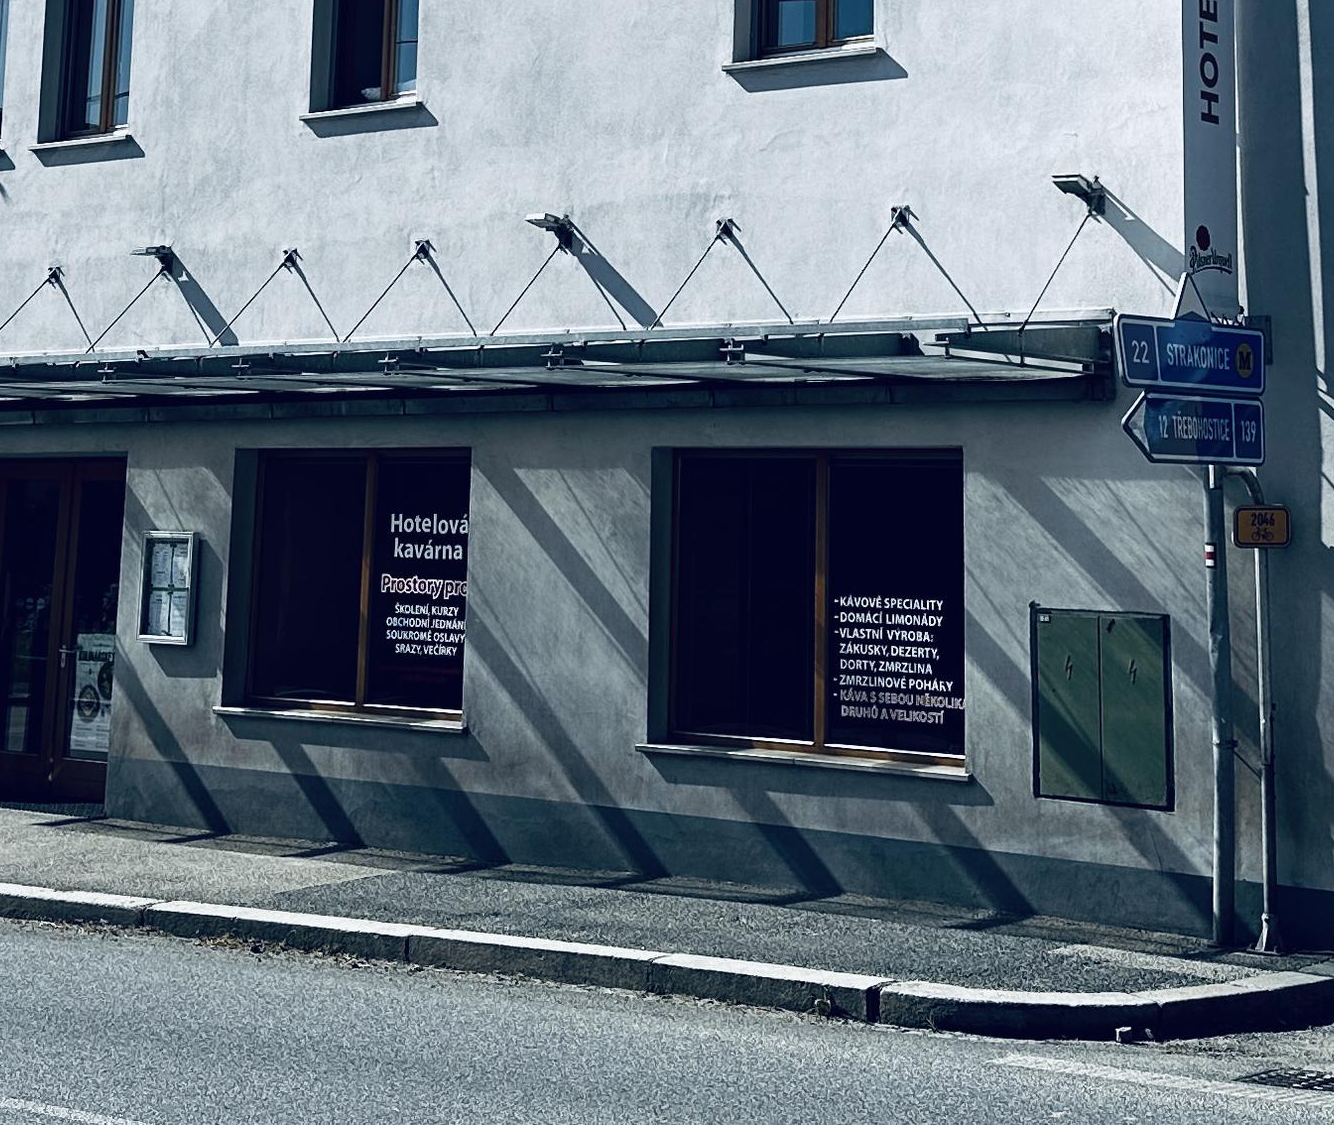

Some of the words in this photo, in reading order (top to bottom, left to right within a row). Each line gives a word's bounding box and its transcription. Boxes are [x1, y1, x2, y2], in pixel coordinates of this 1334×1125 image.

[1131, 339, 1150, 364] 22
[1167, 342, 1230, 371] STRAKONICE
[1158, 415, 1169, 439] 12
[1172, 410, 1230, 442] TŘEBOHOSTICE
[1241, 420, 1257, 443] 139
[390, 513, 469, 535] Hotelová
[1251, 512, 1275, 527] 2046
[393, 537, 463, 560] kavárna
[381, 573, 443, 599] Prostory
[431, 605, 459, 617] KURZY
[883, 597, 944, 611] SPECIALITY
[386, 617, 430, 629] OBCHODNÍ
[885, 613, 943, 627] LIMONÁDY
[386, 630, 433, 642] SOUKROMÉ
[433, 632, 467, 644] OSLAVY
[395, 644, 422, 656] SRAZY,
[423, 644, 458, 657] VEČÍRKY
[839, 641, 890, 656] ZÁKUSKY,
[890, 645, 940, 661] DEZERTY,
[840, 659, 877, 673] DORTY,
[878, 661, 933, 676] ZMRZLINA
[839, 674, 907, 690] ZMRZLINOVÉ
[908, 678, 954, 692] POHÁRY
[840, 688, 869, 702] KÁVA
[869, 691, 877, 703] S
[878, 692, 915, 706] SEBOU
[879, 708, 889, 720] A
[889, 710, 945, 725] VELIKOSTÍ
